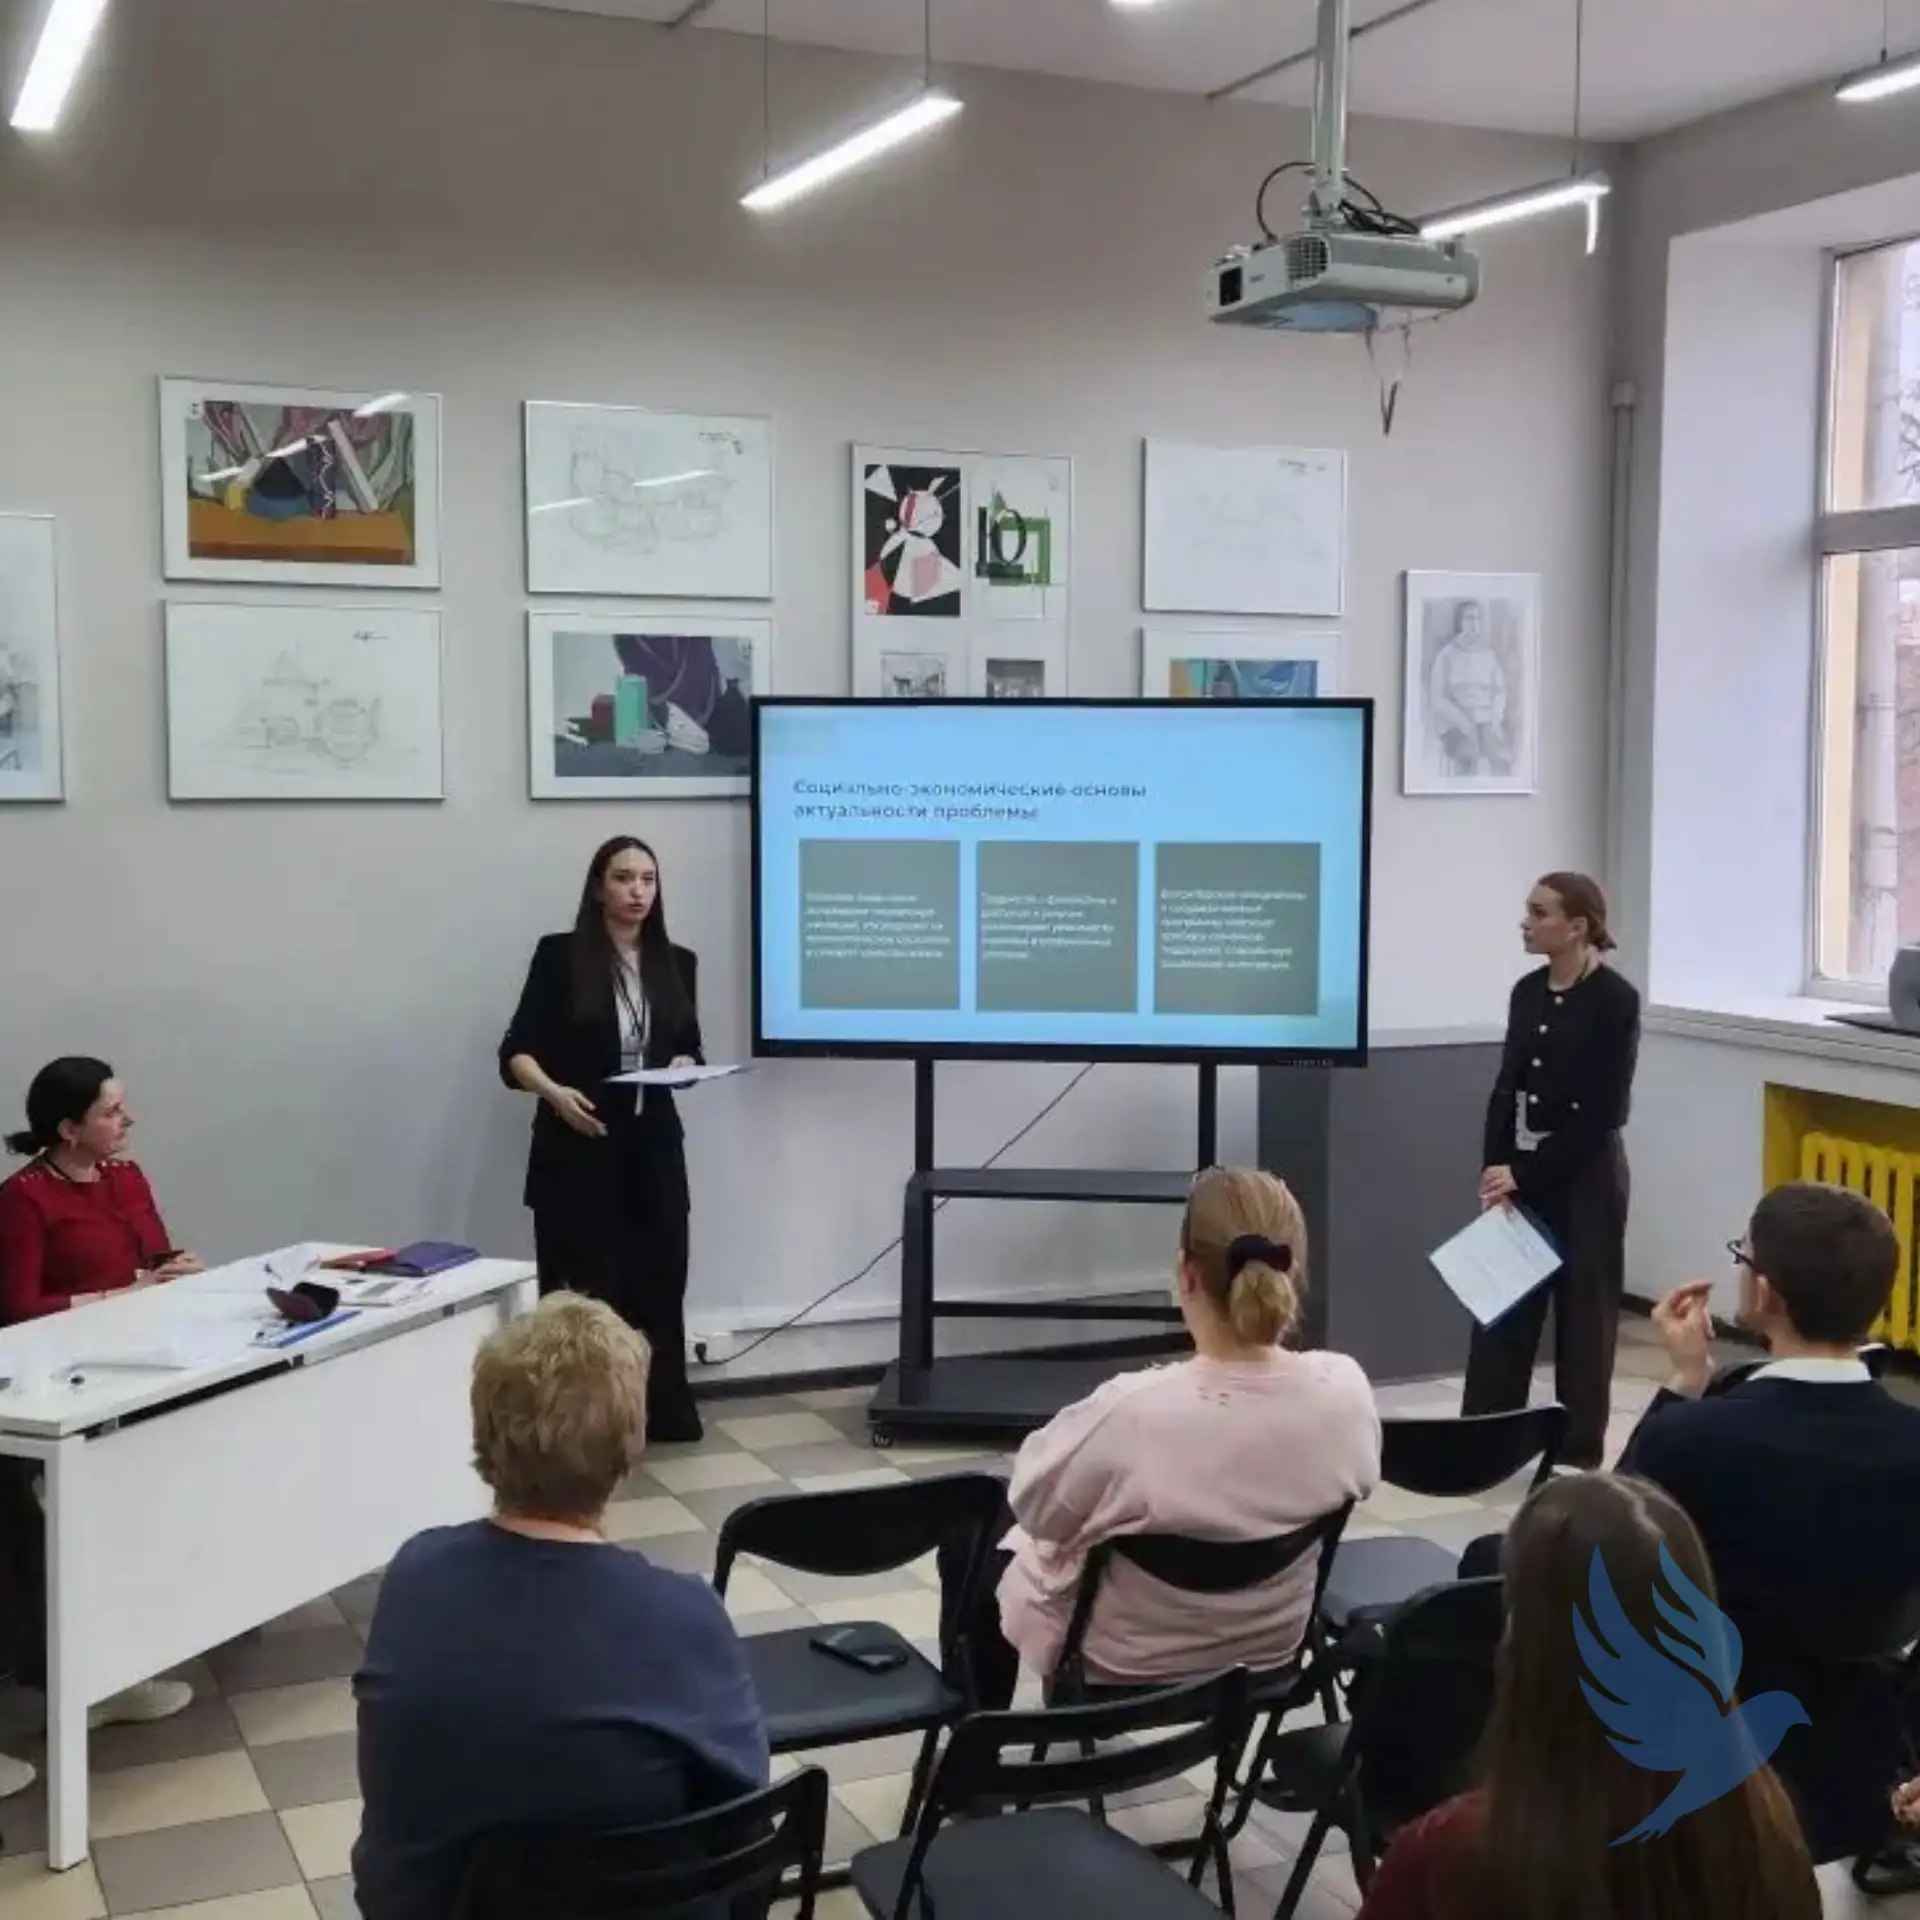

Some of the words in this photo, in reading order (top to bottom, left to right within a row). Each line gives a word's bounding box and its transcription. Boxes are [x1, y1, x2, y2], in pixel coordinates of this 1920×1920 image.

[1071, 783, 1147, 797] основы
[794, 804, 927, 819] актуальности
[934, 803, 1038, 821] проблемы
